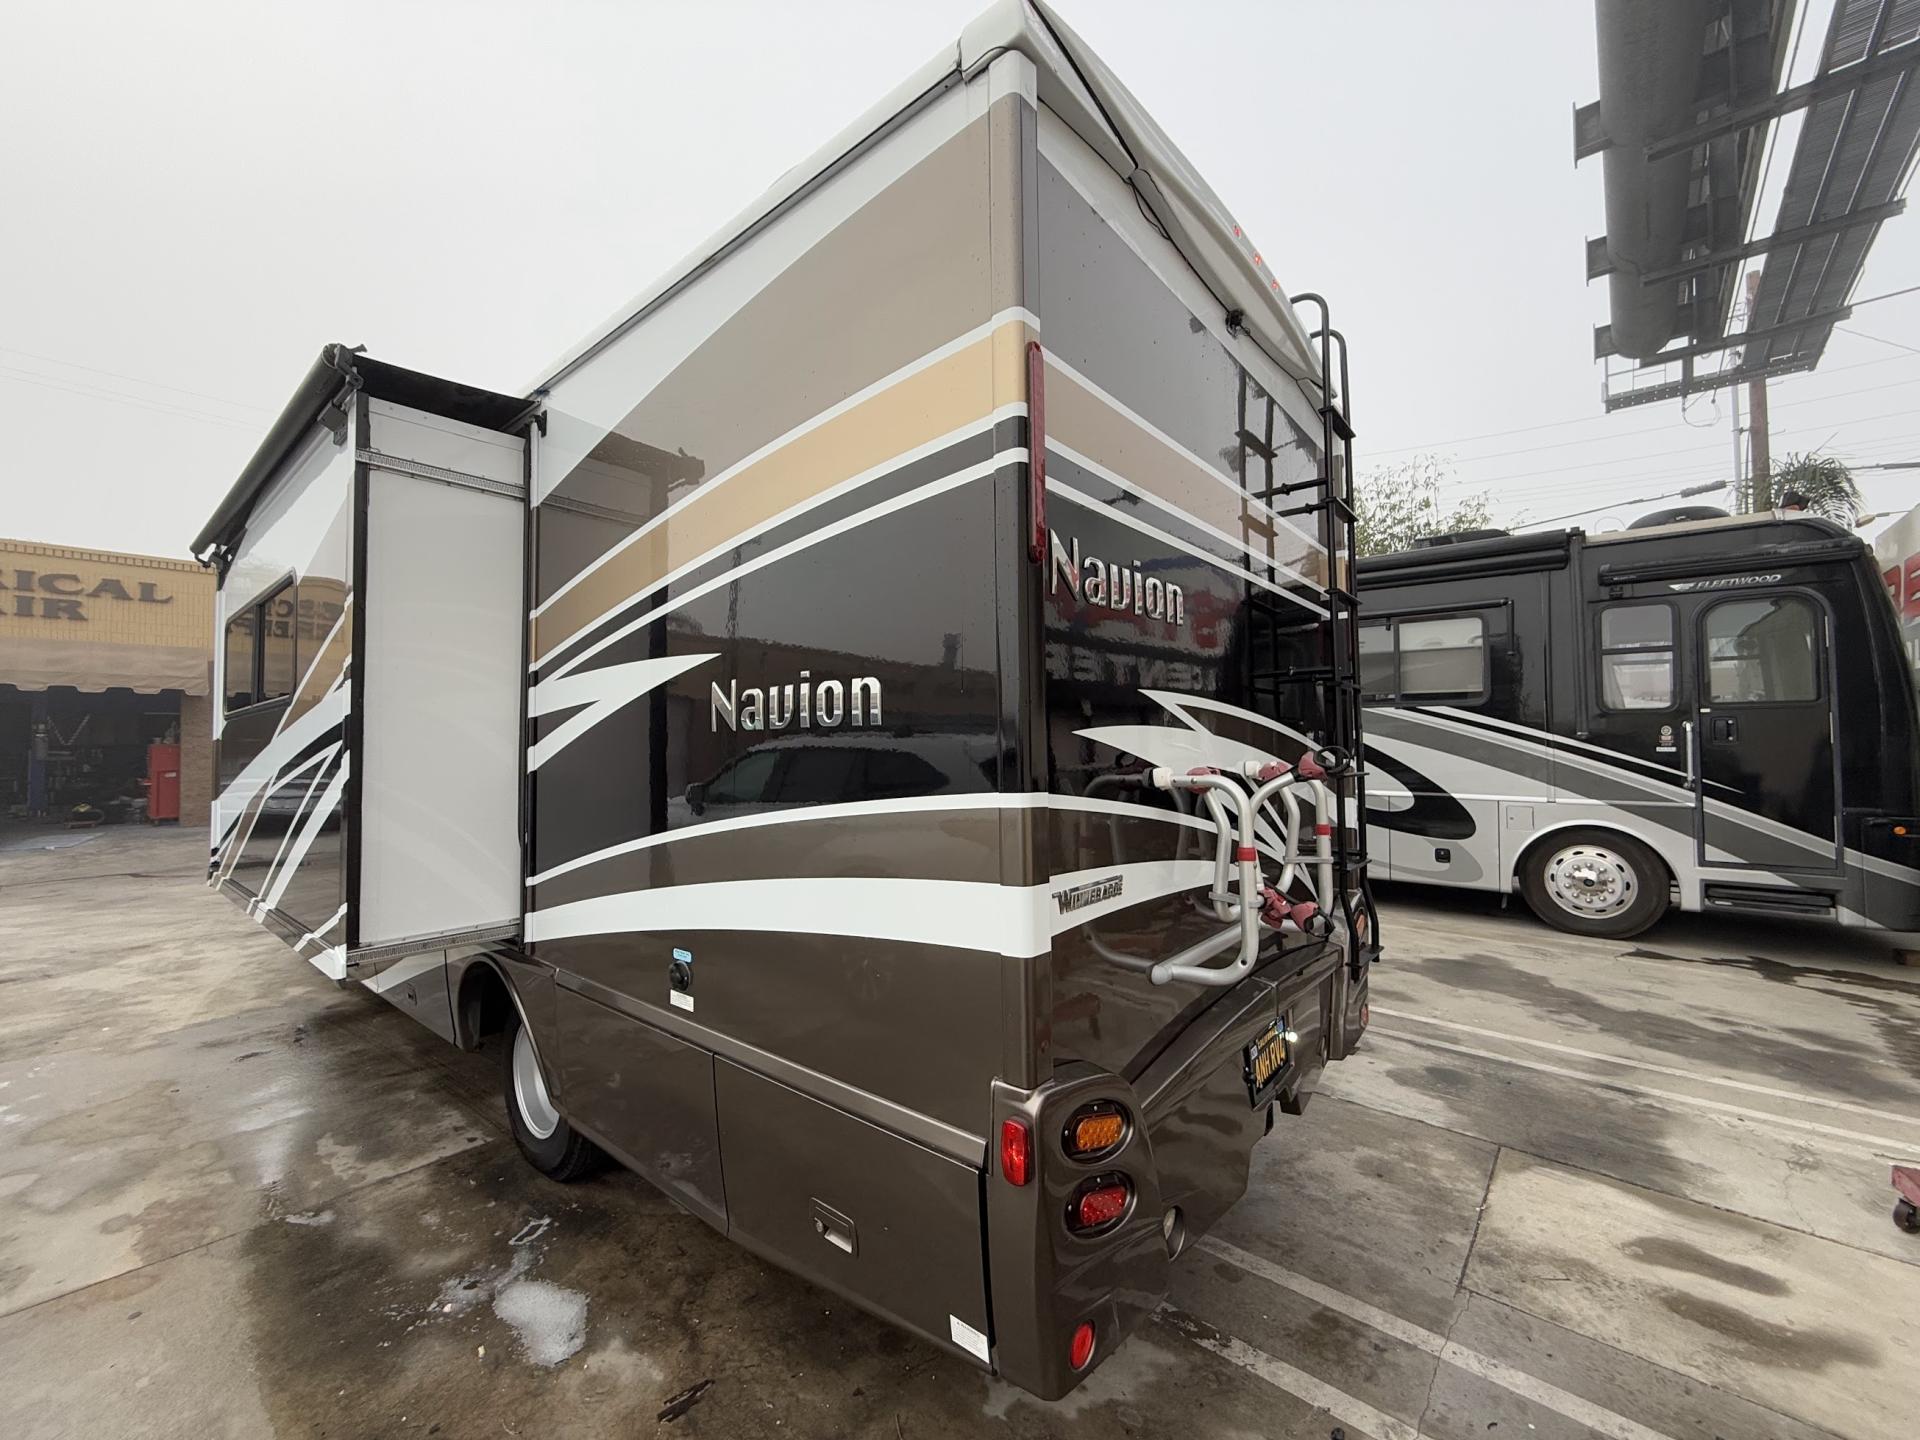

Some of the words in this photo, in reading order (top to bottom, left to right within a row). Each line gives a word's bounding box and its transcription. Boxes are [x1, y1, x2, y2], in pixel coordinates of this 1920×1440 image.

[0, 568, 174, 604] ICAL
[1049, 527, 1184, 625] Navion
[1696, 573, 1782, 590] FLEETWOOD
[0, 595, 89, 621] IR
[711, 670, 882, 733] Navion
